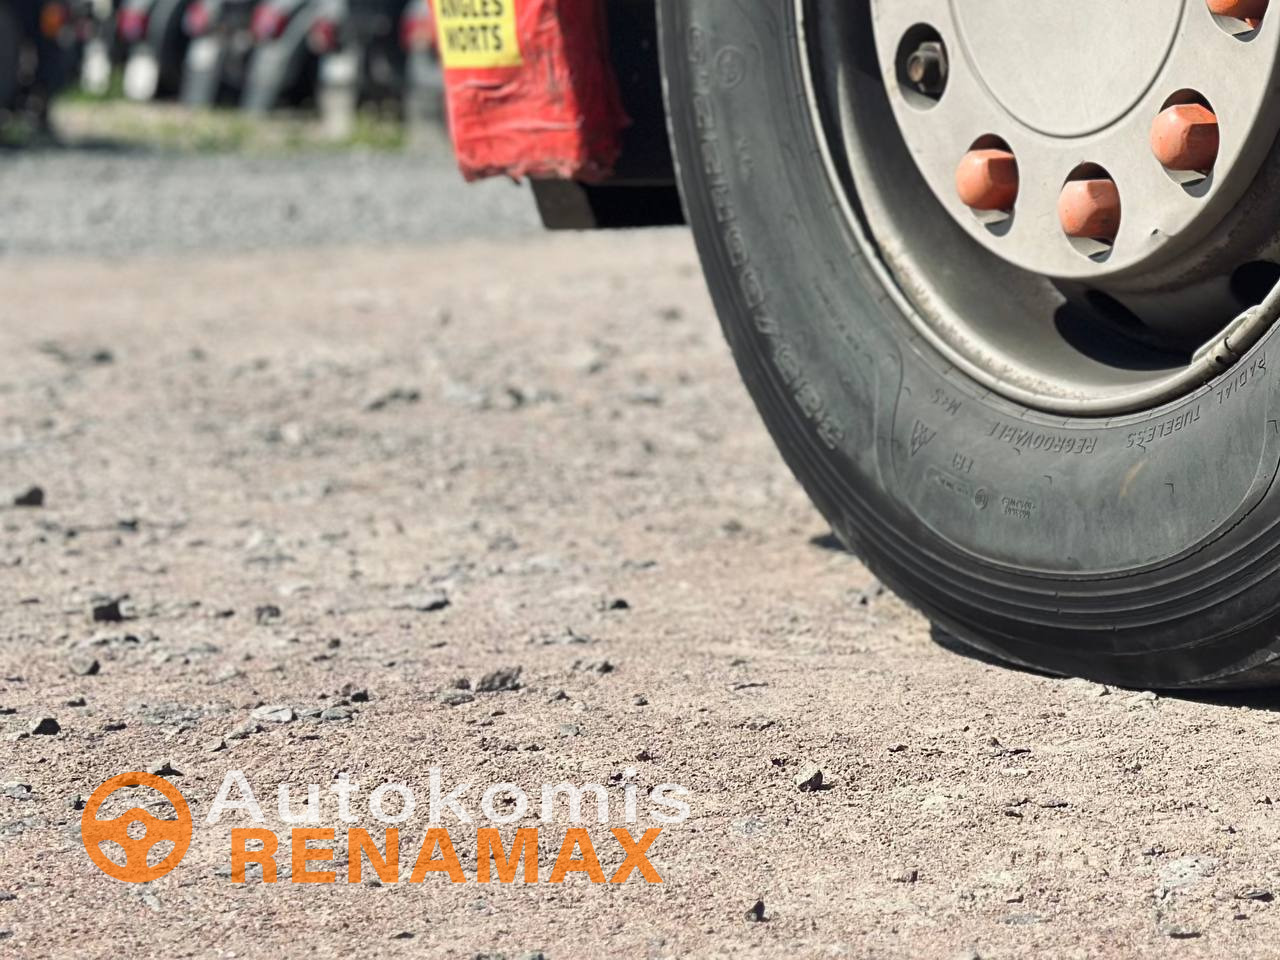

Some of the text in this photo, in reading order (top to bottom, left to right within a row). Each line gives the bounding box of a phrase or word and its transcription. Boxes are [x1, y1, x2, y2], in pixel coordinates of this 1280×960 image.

[1216, 351, 1267, 405] RADIAL
[989, 421, 1098, 455] REGROOVABLE
[1126, 404, 1201, 449] TUBELESS
